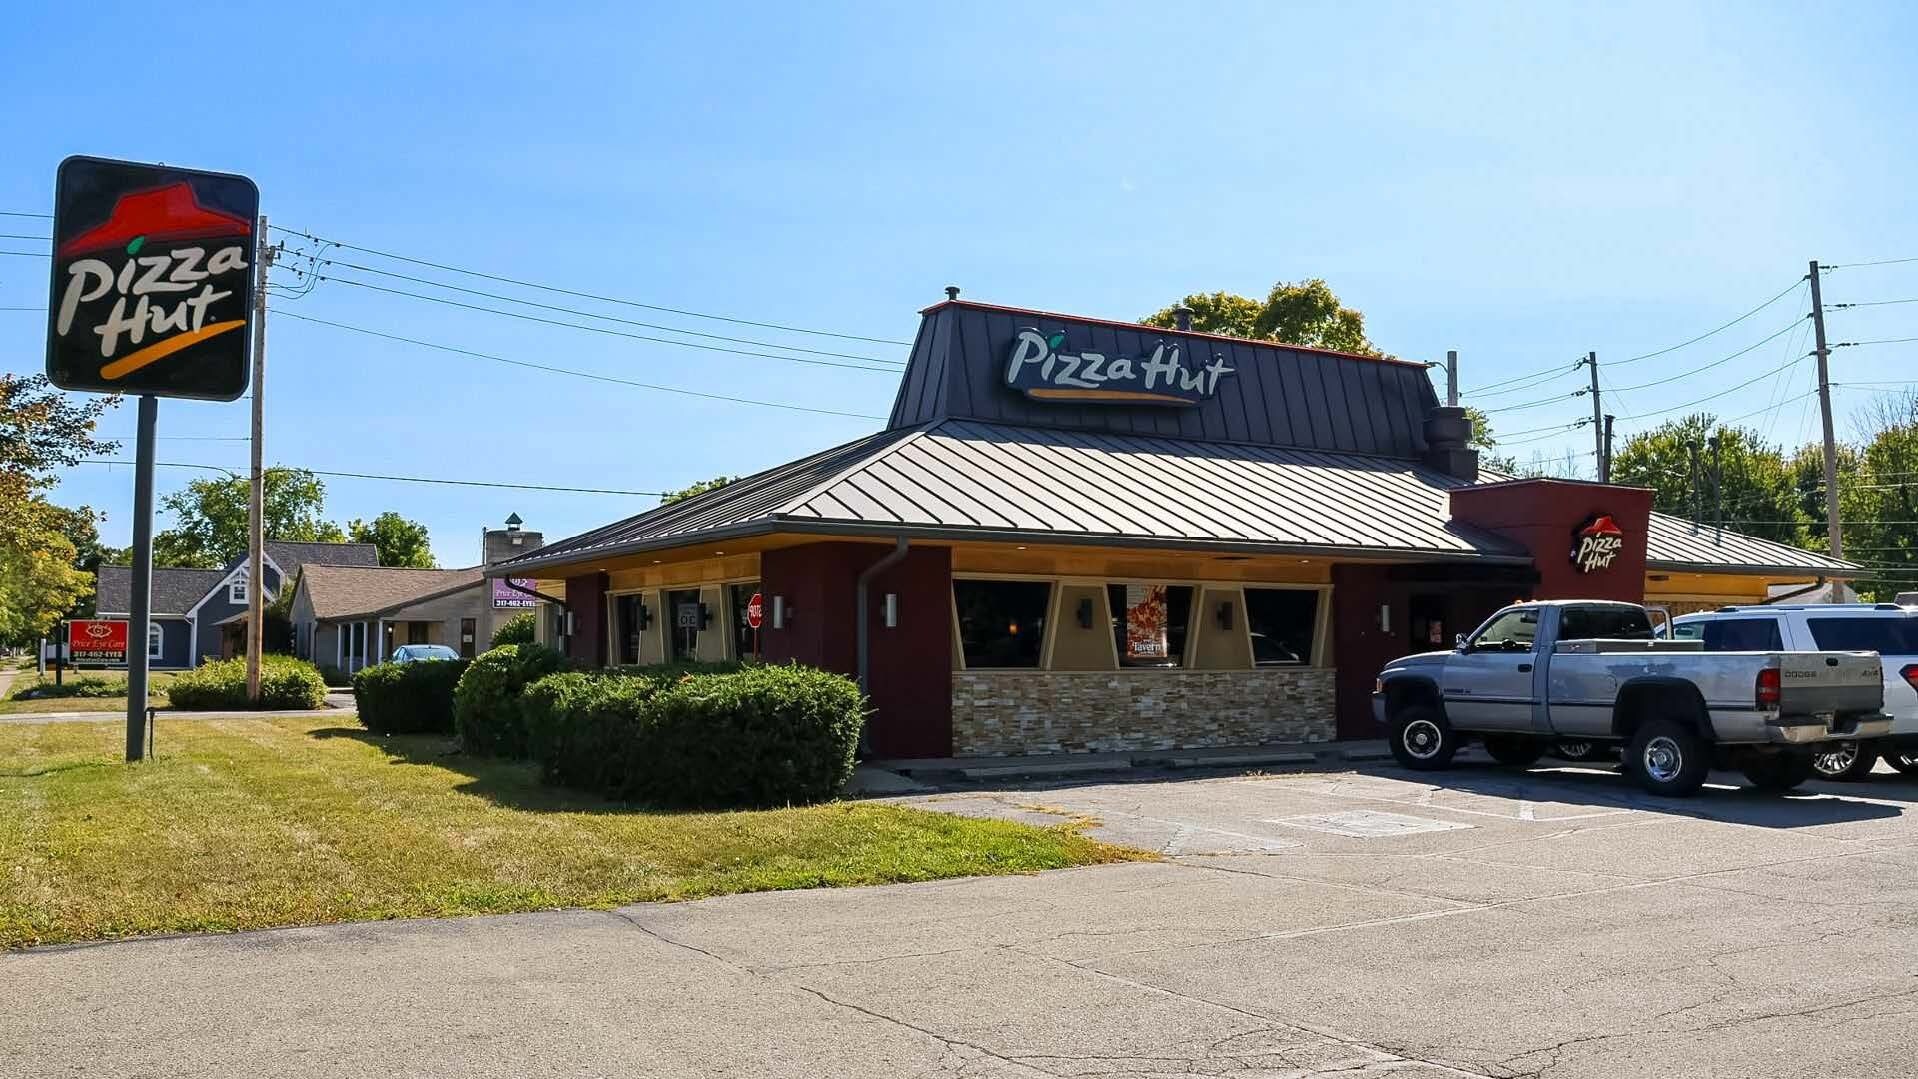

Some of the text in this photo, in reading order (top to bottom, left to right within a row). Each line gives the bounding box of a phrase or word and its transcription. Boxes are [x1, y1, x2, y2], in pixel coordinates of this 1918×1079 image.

[57, 236, 249, 337] Pizza
[94, 284, 233, 358] Hut
[1007, 329, 1236, 395] Pizza Hut
[1577, 532, 1623, 564] Pizza
[1584, 551, 1616, 573] Hut
[1132, 642, 1161, 652] Tavern
[1784, 670, 1817, 678] DODGE
